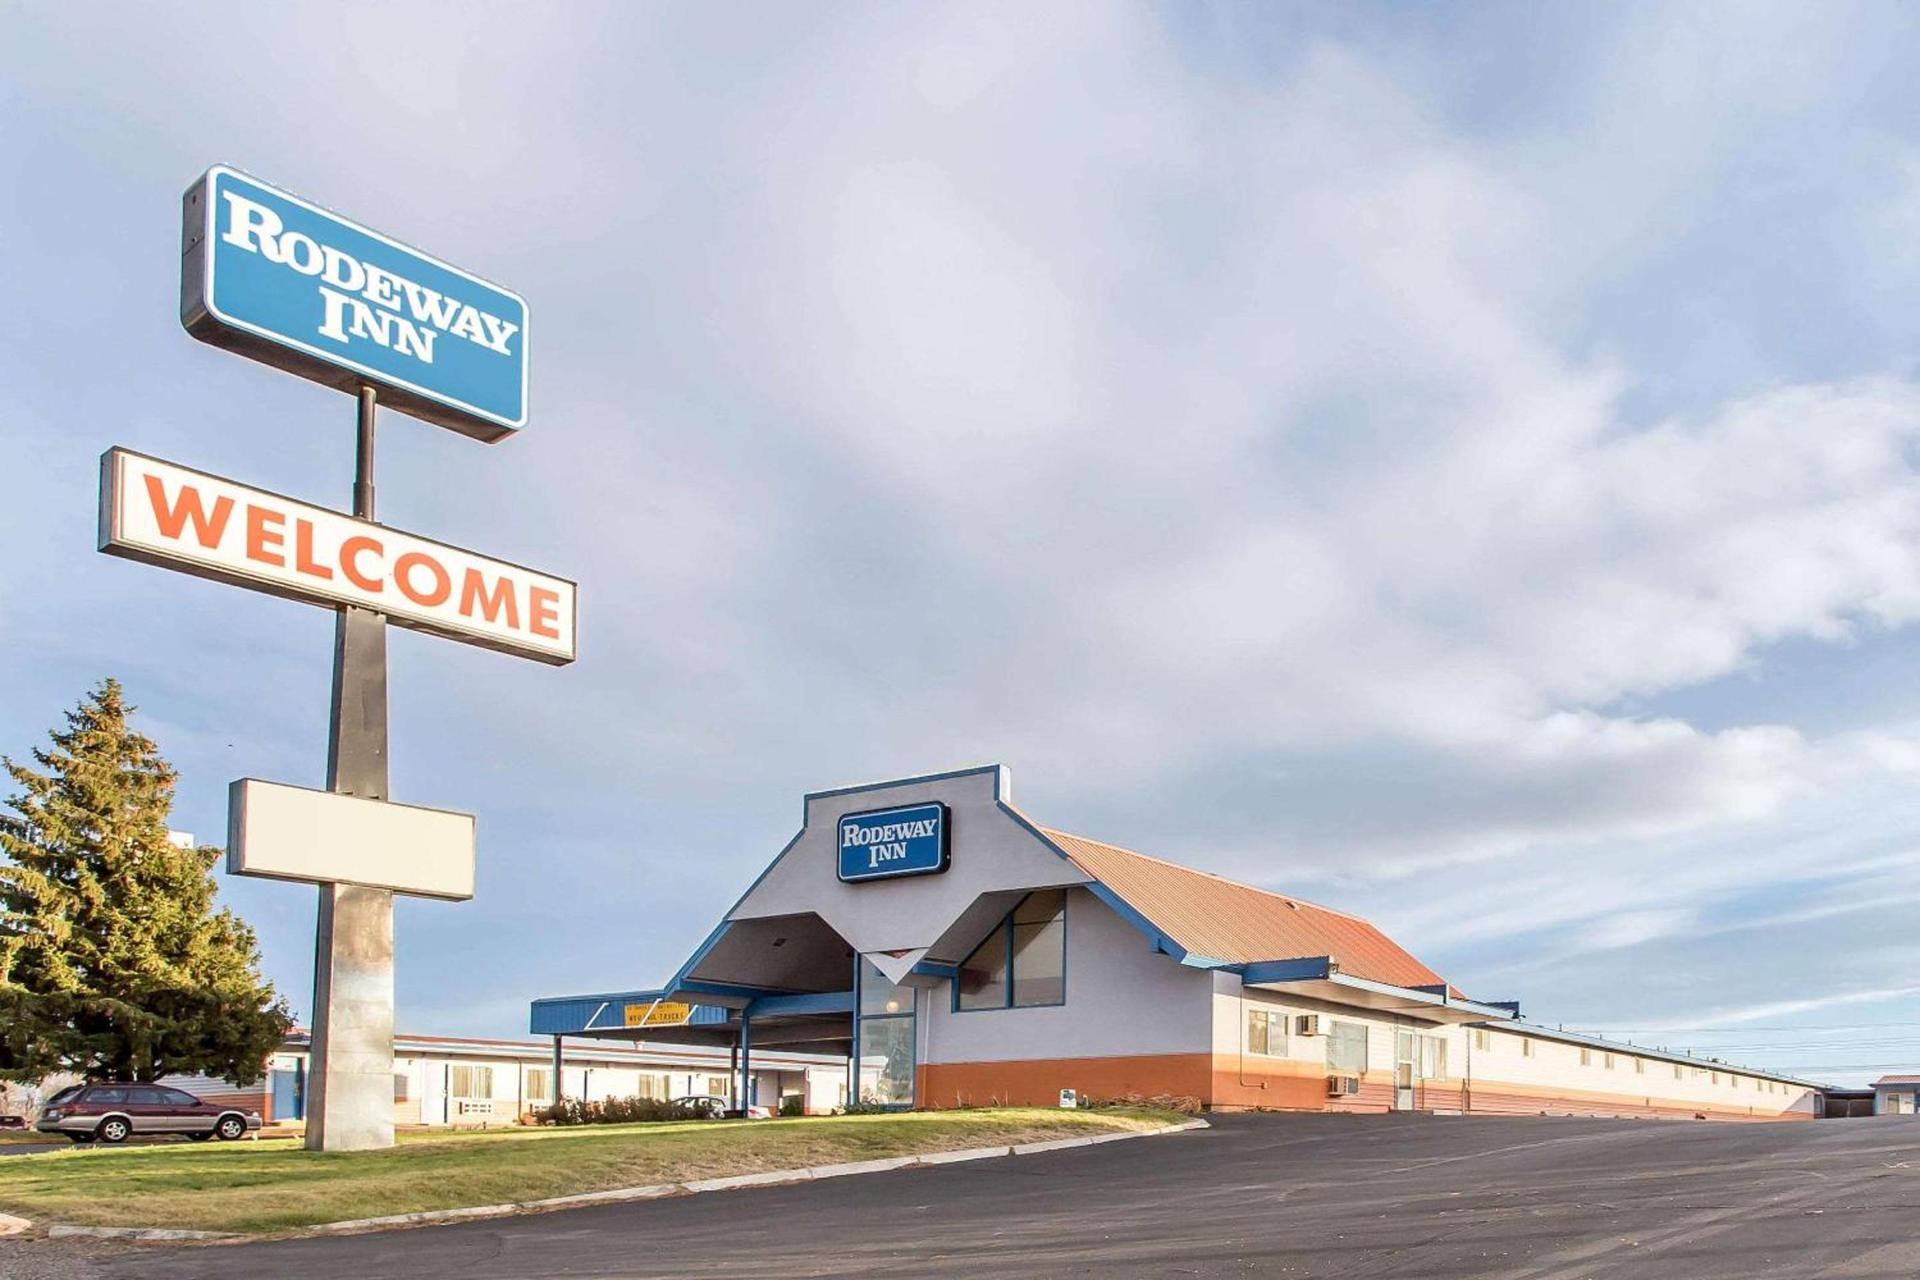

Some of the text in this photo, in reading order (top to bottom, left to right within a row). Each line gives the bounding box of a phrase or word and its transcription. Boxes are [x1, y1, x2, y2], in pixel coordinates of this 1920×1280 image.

[222, 189, 519, 356] RODEWAY
[318, 286, 438, 364] INN
[143, 474, 560, 639] WELCOME
[842, 819, 938, 848] RODEWAY
[868, 841, 907, 868] INN
